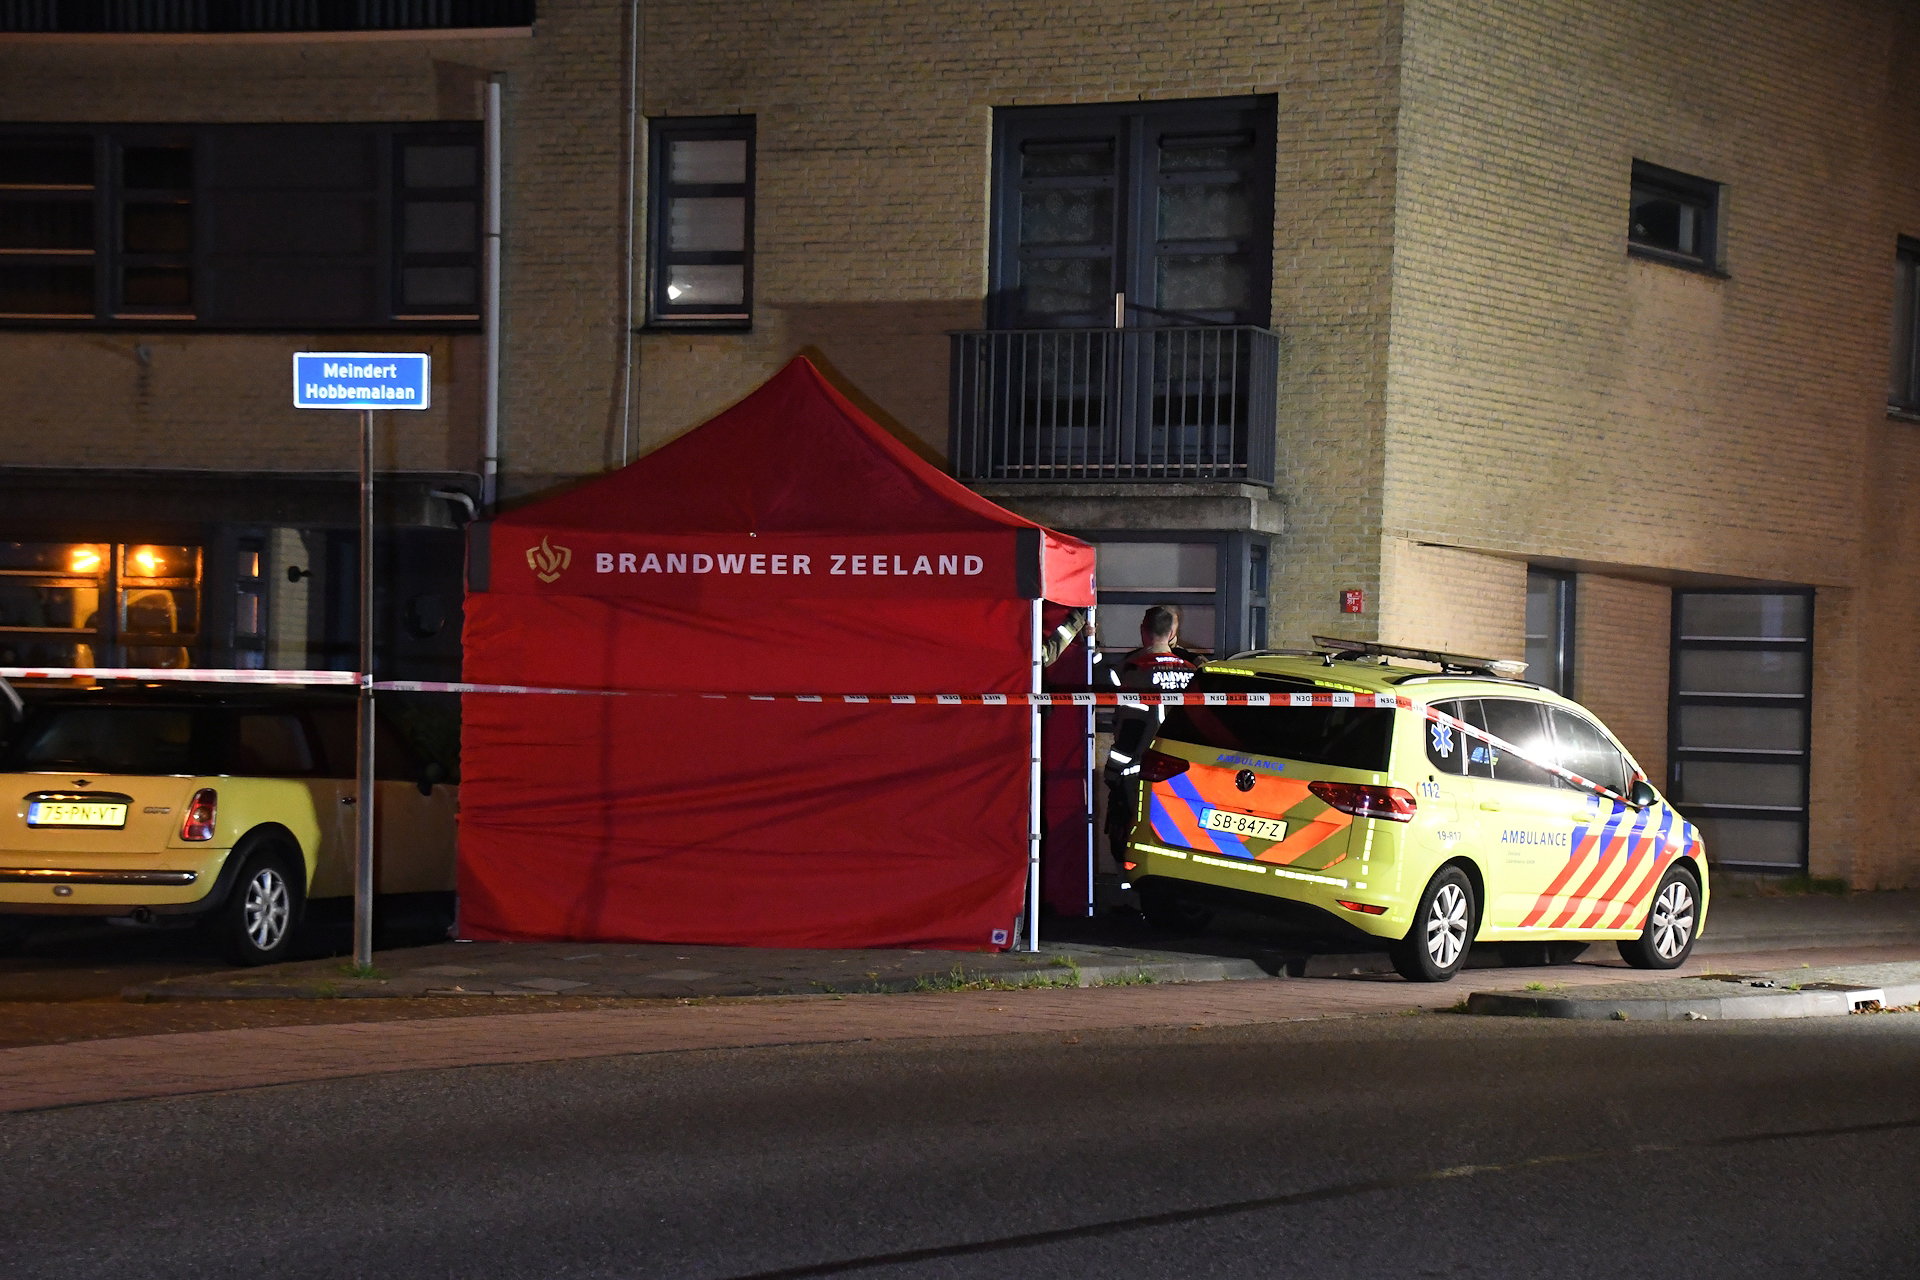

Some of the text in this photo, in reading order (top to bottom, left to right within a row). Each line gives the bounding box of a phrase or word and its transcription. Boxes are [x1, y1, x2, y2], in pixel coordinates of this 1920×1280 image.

[323, 363, 397, 378] Meindert
[305, 383, 415, 399] Hobbemalaan
[596, 553, 984, 575] BRANDWEER ZEELAND
[1210, 694, 1249, 702] BETREDEN
[1217, 754, 1286, 772] AMBULANCE
[44, 806, 118, 821] 75-PN-VT
[1213, 813, 1280, 837] SB-847-Z
[1501, 829, 1567, 847] AMBULANCE
